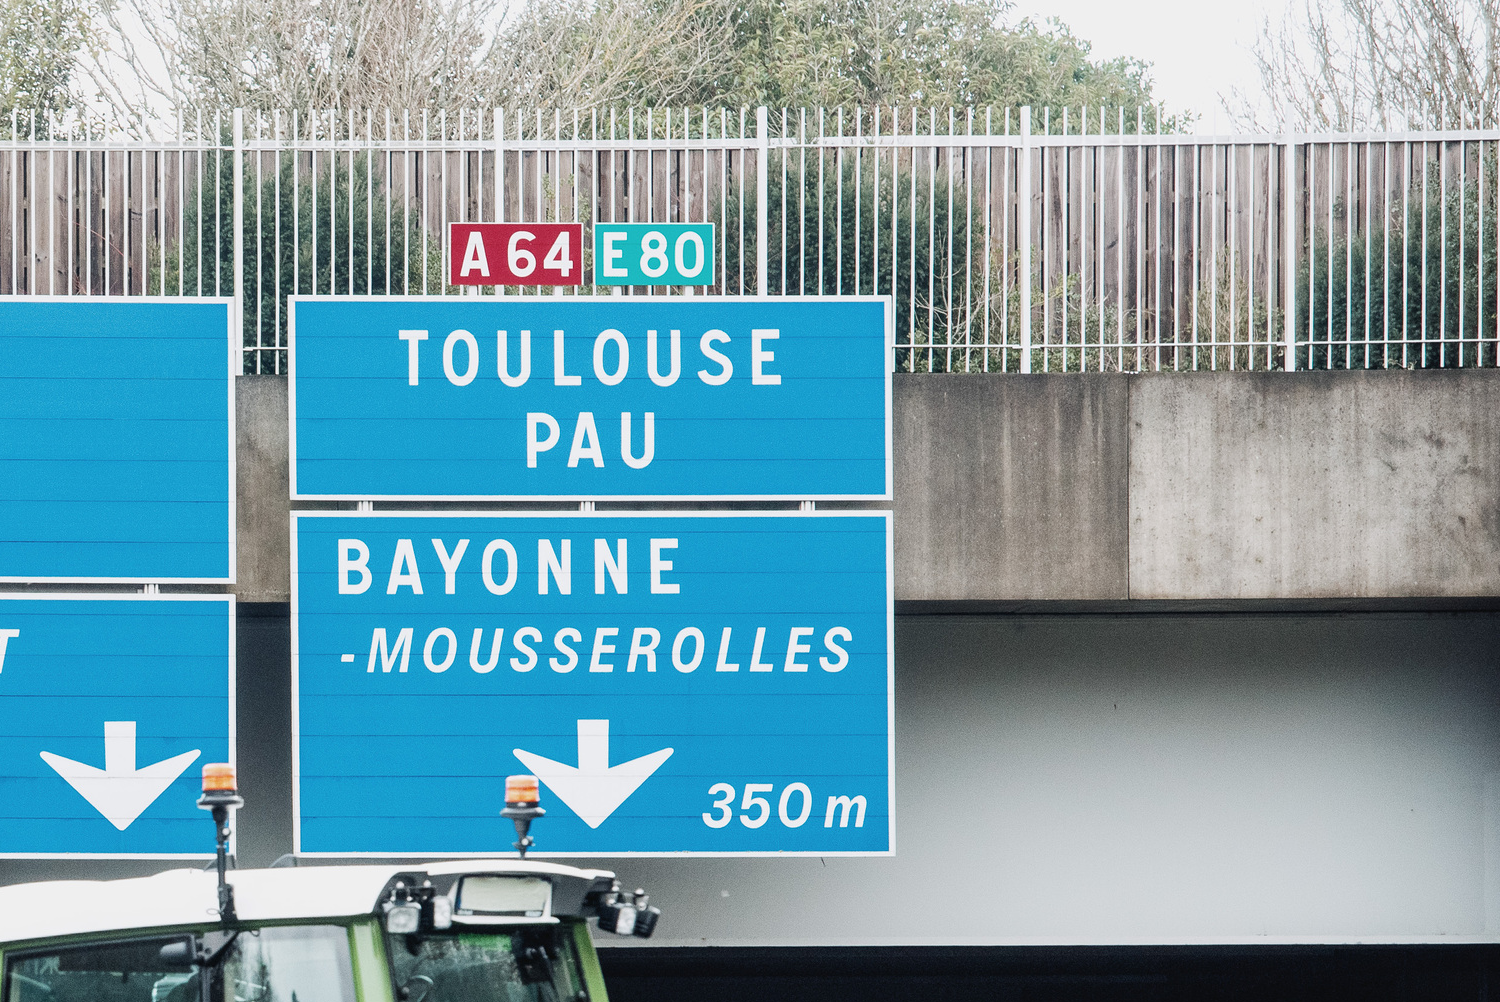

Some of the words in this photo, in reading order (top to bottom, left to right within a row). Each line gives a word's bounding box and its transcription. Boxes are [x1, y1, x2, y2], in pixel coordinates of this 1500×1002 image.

[399, 329, 781, 387] TOULOUSE
[527, 412, 654, 469] PAU
[338, 538, 680, 595] BAYONNE
[341, 627, 852, 673] -MOUSSEROLLES
[702, 782, 812, 828] 350
[824, 795, 866, 827] m
